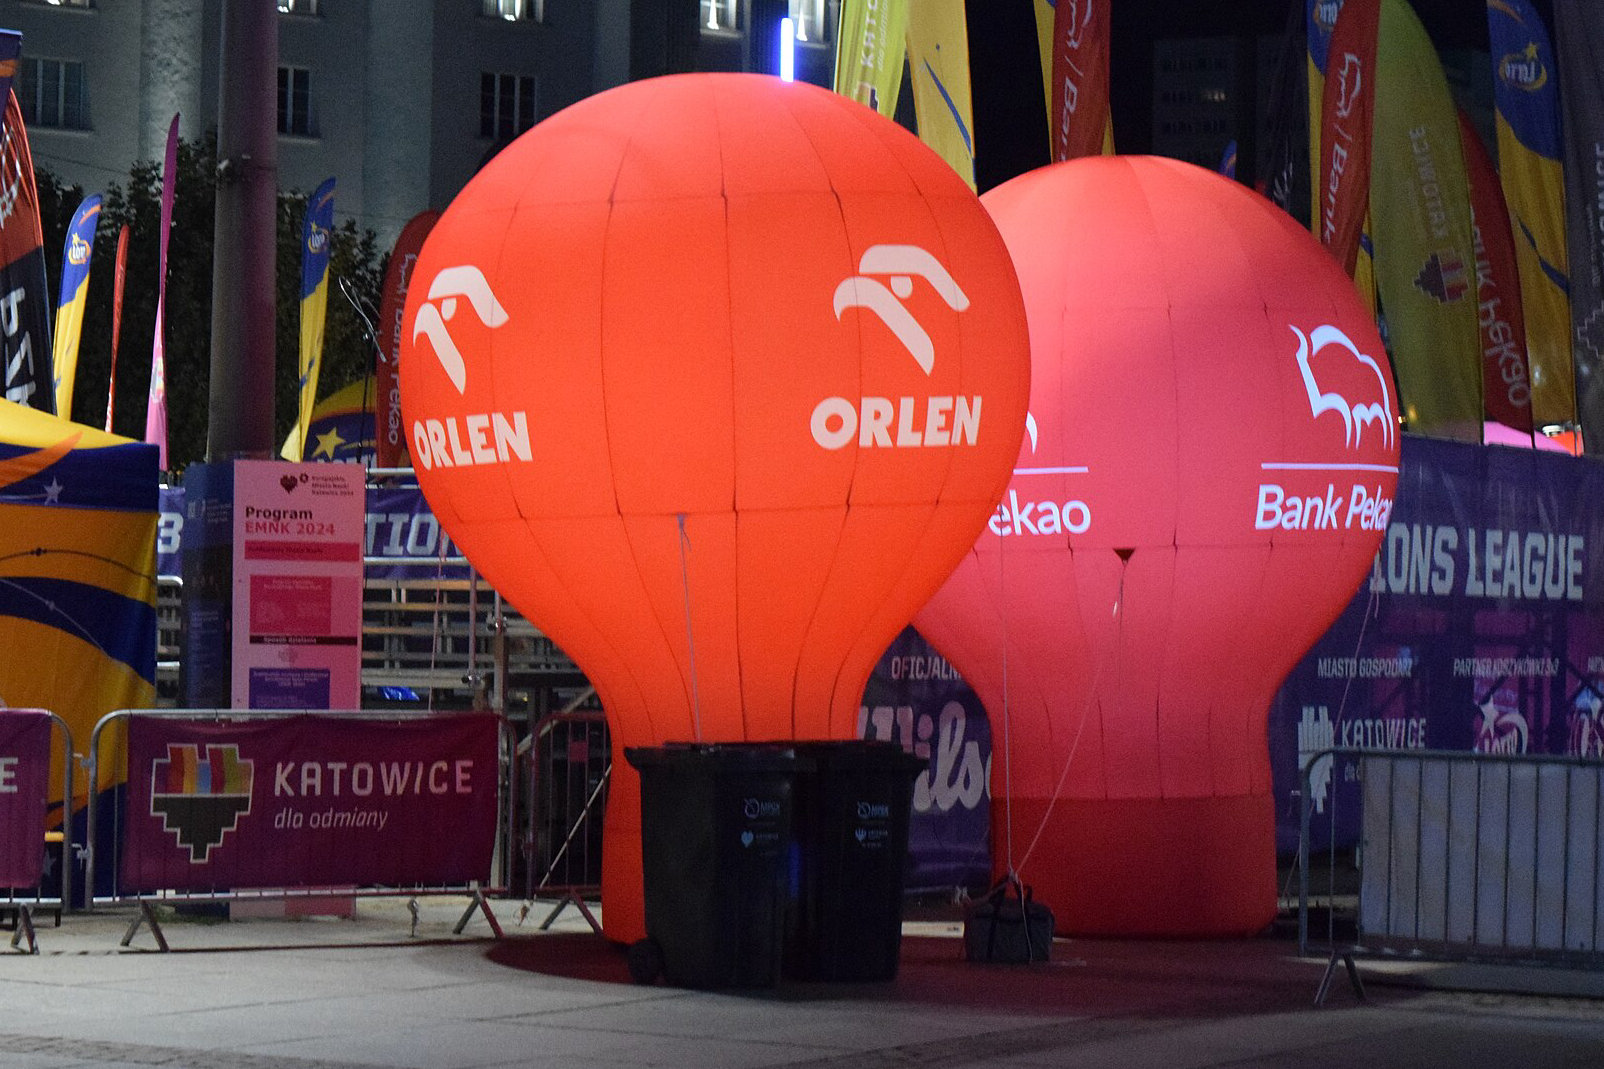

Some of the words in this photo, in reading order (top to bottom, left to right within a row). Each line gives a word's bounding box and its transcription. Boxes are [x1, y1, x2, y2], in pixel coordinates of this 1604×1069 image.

[810, 396, 982, 450] ORLEN
[413, 411, 533, 470] ORLEN
[245, 506, 313, 521] Program
[1255, 483, 1344, 531] Bank
[245, 521, 290, 534] EMNK
[296, 522, 335, 535] 2024
[1465, 527, 1584, 600] LEAGUE
[1317, 657, 1357, 678] MIASTO
[1359, 657, 1413, 678] GOSPODARZ
[1453, 658, 1492, 679] PARTNER
[1341, 718, 1427, 749] KATOWICE
[274, 759, 474, 796] KATOWICE
[274, 808, 303, 829] dla
[309, 806, 388, 832] odmiany
